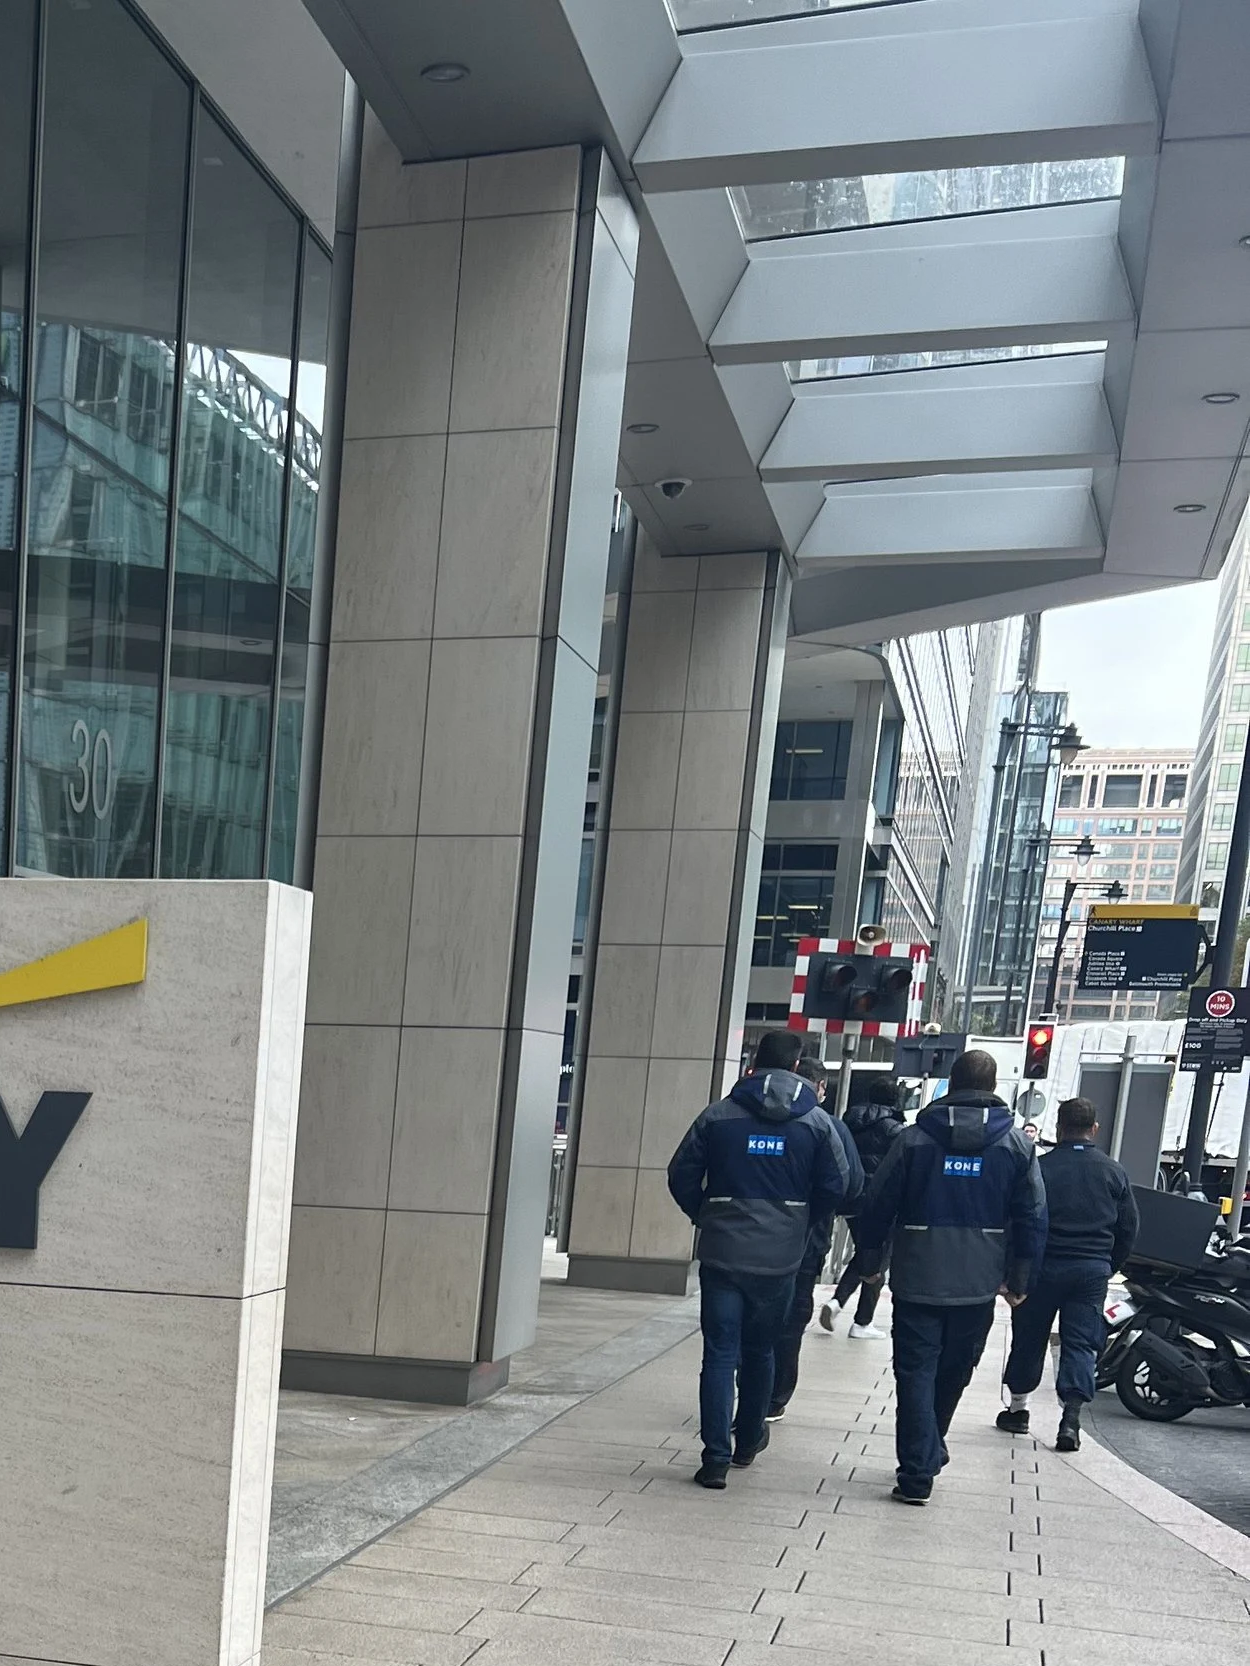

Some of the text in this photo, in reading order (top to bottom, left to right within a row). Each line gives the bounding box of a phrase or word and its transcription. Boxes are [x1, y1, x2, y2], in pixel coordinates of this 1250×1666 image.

[70, 719, 111, 820] 30
[1216, 995, 1227, 1003] 10
[749, 1140, 785, 1151] KONE
[944, 1161, 981, 1172] KONE
[1105, 1304, 1121, 1319] L
